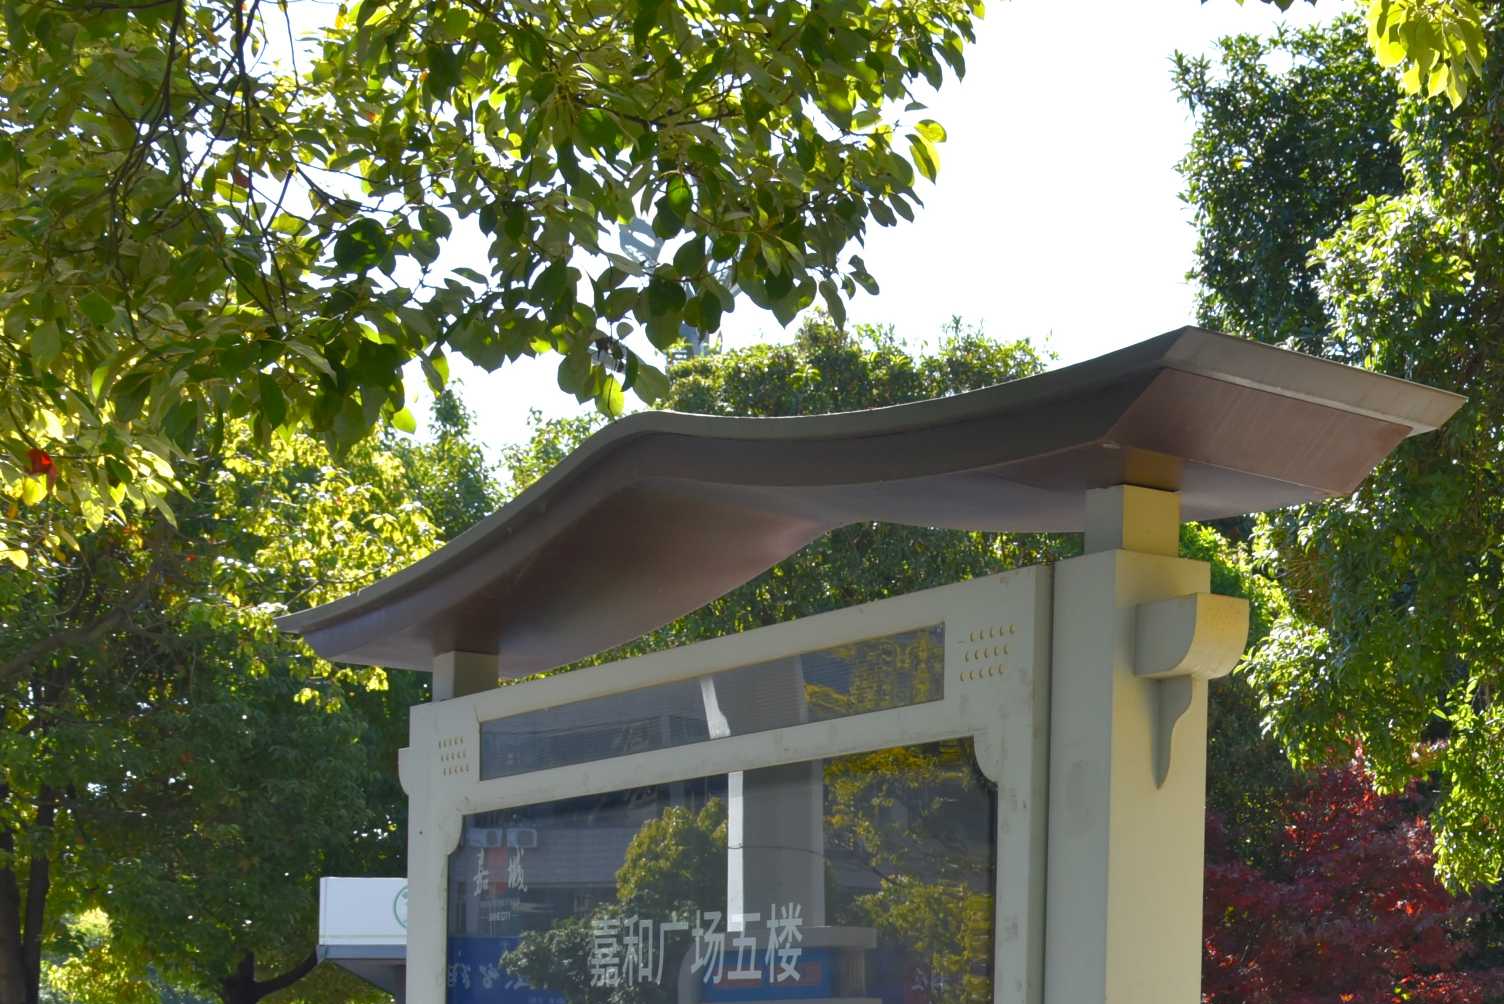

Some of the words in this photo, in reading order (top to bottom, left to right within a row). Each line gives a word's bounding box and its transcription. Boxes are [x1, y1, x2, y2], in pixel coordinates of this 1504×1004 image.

[589, 902, 803, 988] 嘉和广场五楼
